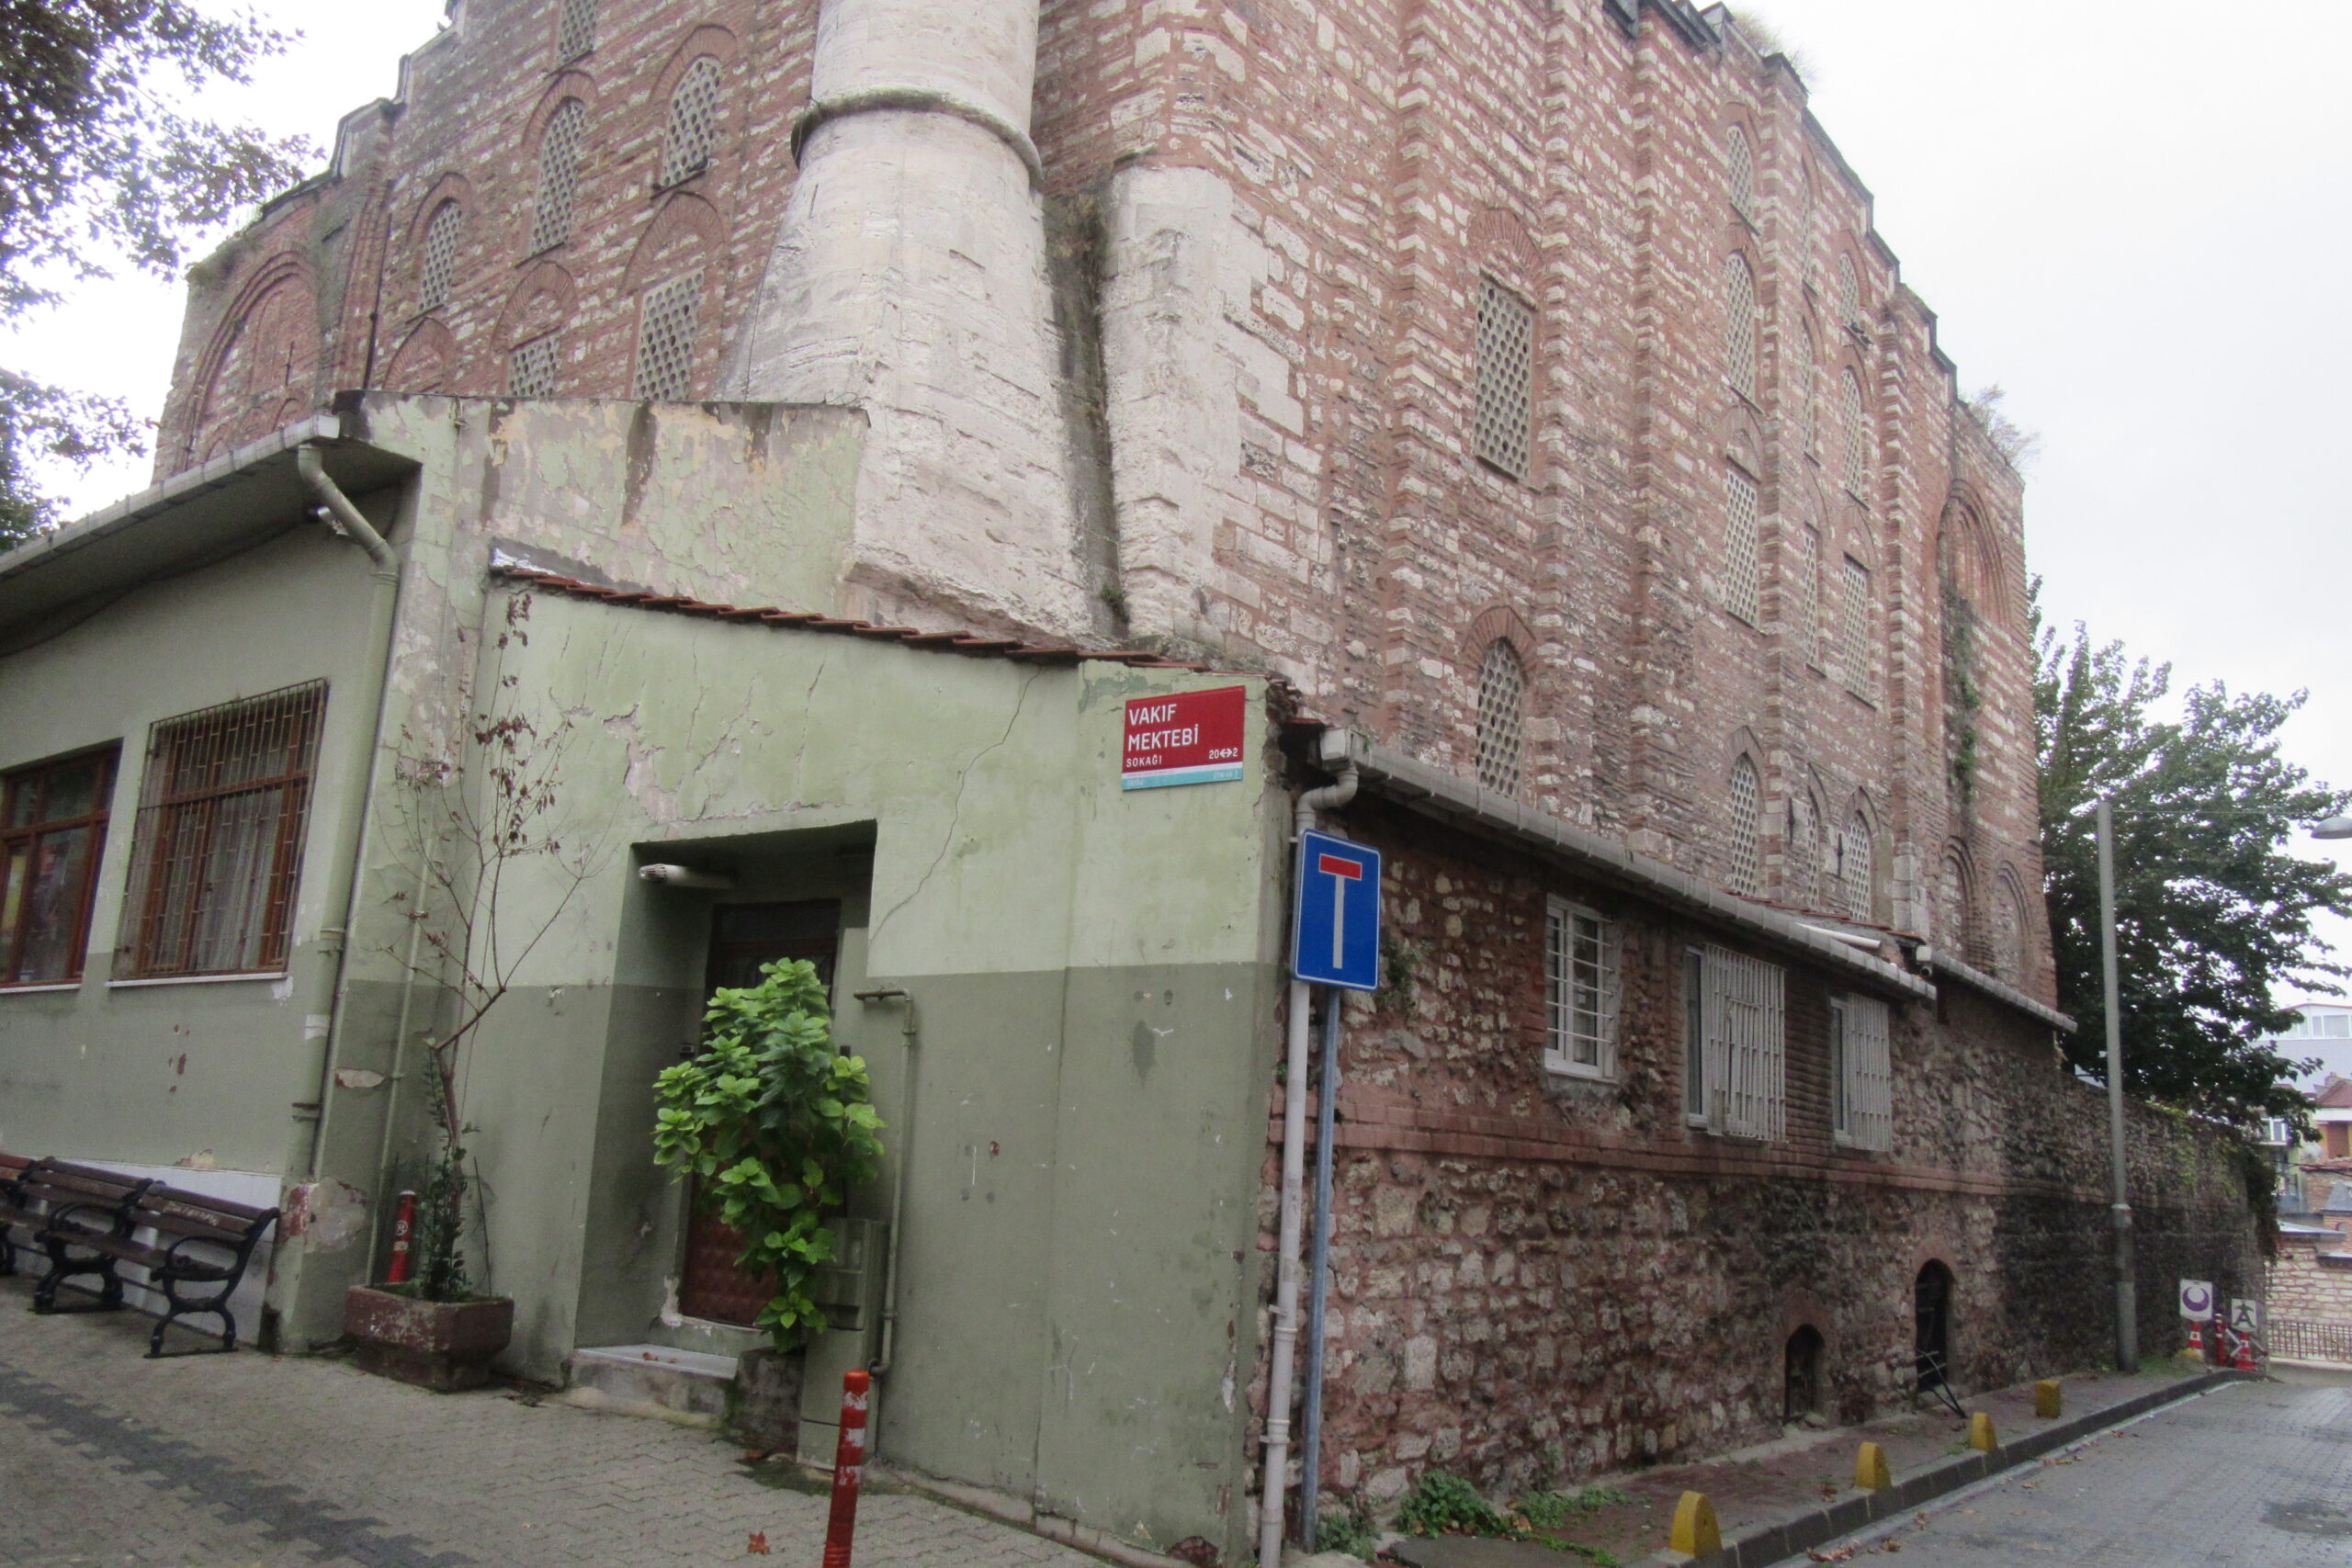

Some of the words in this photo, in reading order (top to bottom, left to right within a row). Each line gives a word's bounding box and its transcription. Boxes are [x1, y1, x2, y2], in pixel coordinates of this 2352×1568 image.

[1129, 704, 1177, 726] VAKIF
[1128, 724, 1199, 751] MEKTEBİ
[1126, 755, 1162, 768] SOKAĞI
